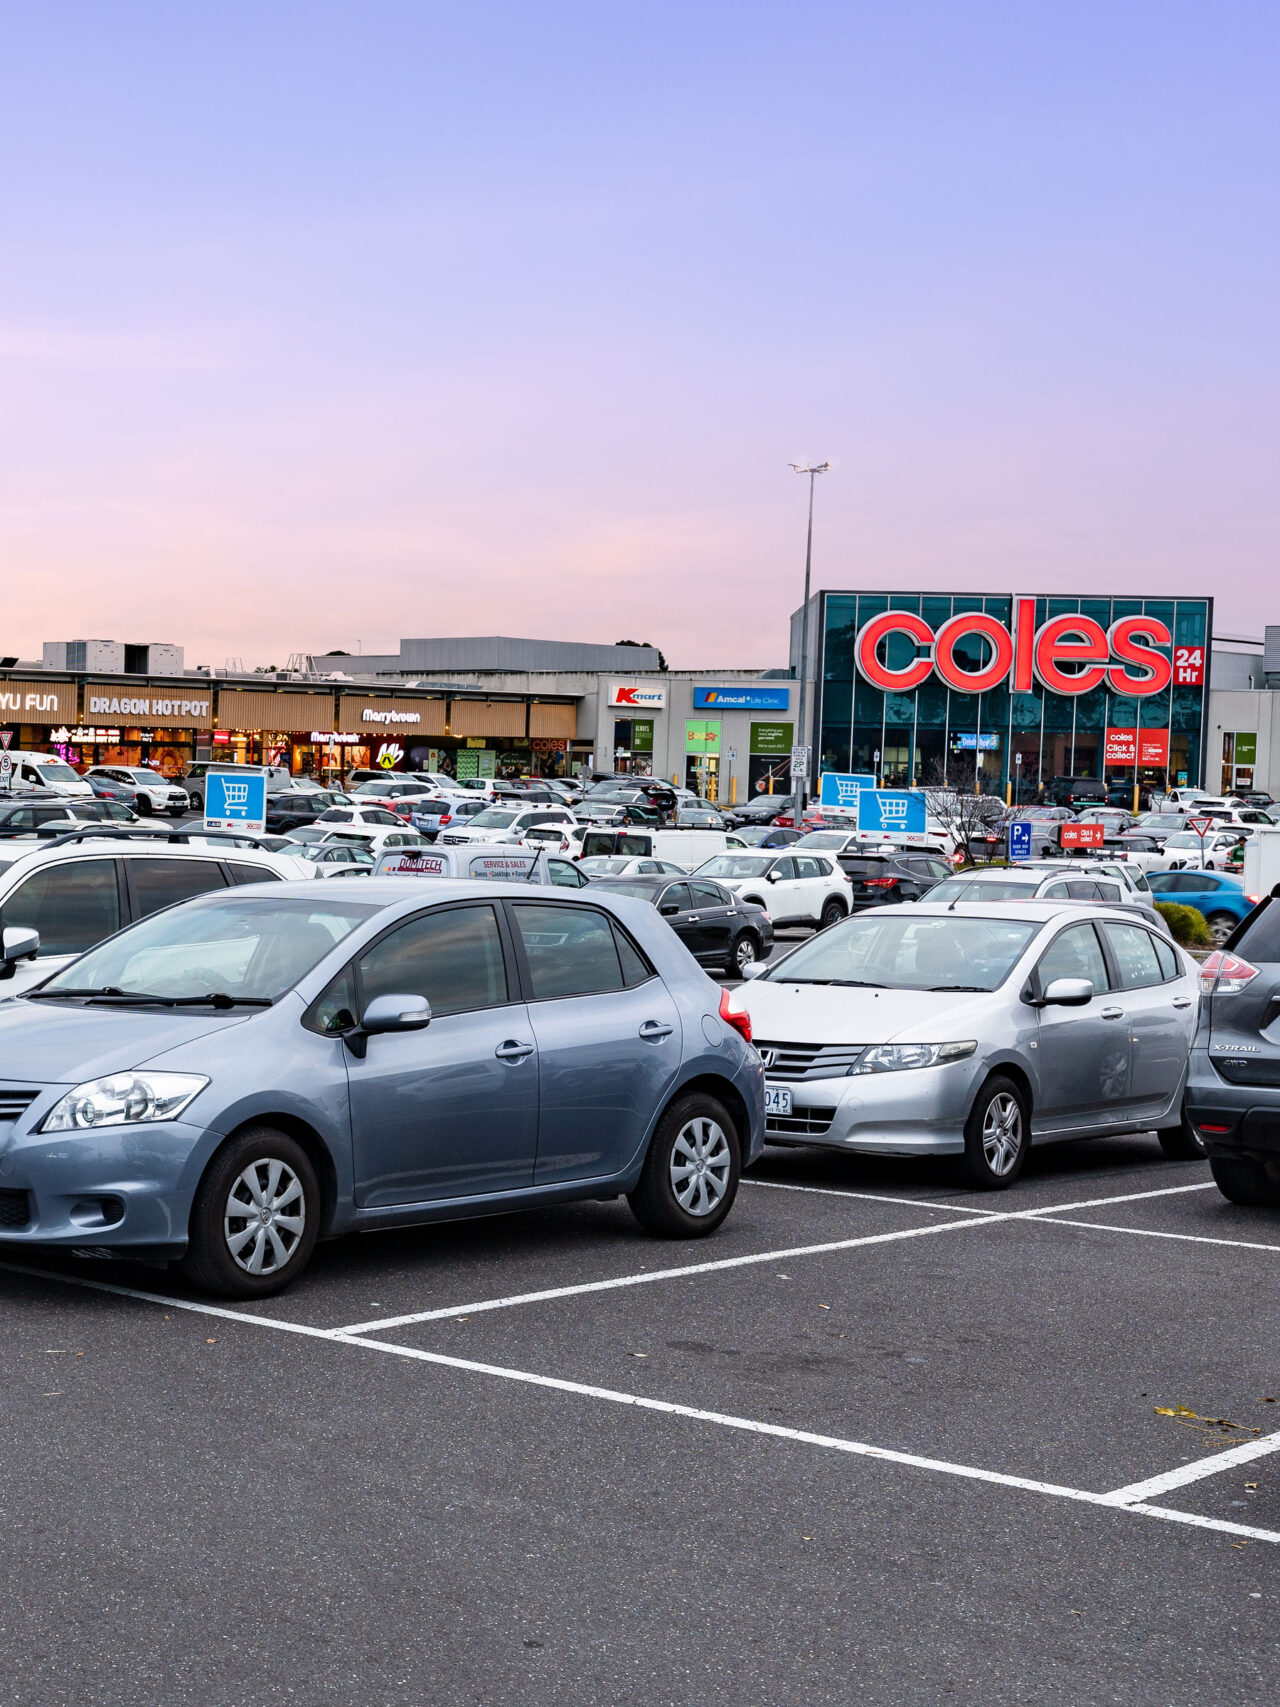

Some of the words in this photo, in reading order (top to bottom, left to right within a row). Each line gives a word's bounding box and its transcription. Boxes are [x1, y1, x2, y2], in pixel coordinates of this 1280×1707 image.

[854, 596, 1172, 698] coles
[1176, 649, 1202, 667] 24
[1178, 667, 1199, 683] Hr
[616, 687, 664, 705] Kmart
[750, 696, 762, 704] Life
[762, 697, 780, 705] Clinic
[25, 693, 58, 712] FUN
[89, 696, 150, 715] DRAGON
[362, 708, 421, 724] Marrybrown
[311, 731, 360, 743] Marrybrown
[687, 731, 718, 742] BOOST
[1110, 733, 1134, 742] coles
[532, 738, 565, 750] coles
[1106, 743, 1128, 752] Click
[1128, 744, 1135, 752] &
[1106, 751, 1135, 760] collect
[3, 758, 9, 768] 5
[1013, 825, 1022, 841] P
[1064, 831, 1078, 839] coles
[483, 860, 505, 869] SERVICE
[505, 860, 510, 868] &
[509, 860, 527, 869] SALES
[491, 870, 511, 878] Cooktops
[1213, 1043, 1262, 1054] X-TRAIL
[1223, 1059, 1248, 1067] 4WD
[764, 1091, 789, 1109] 045
